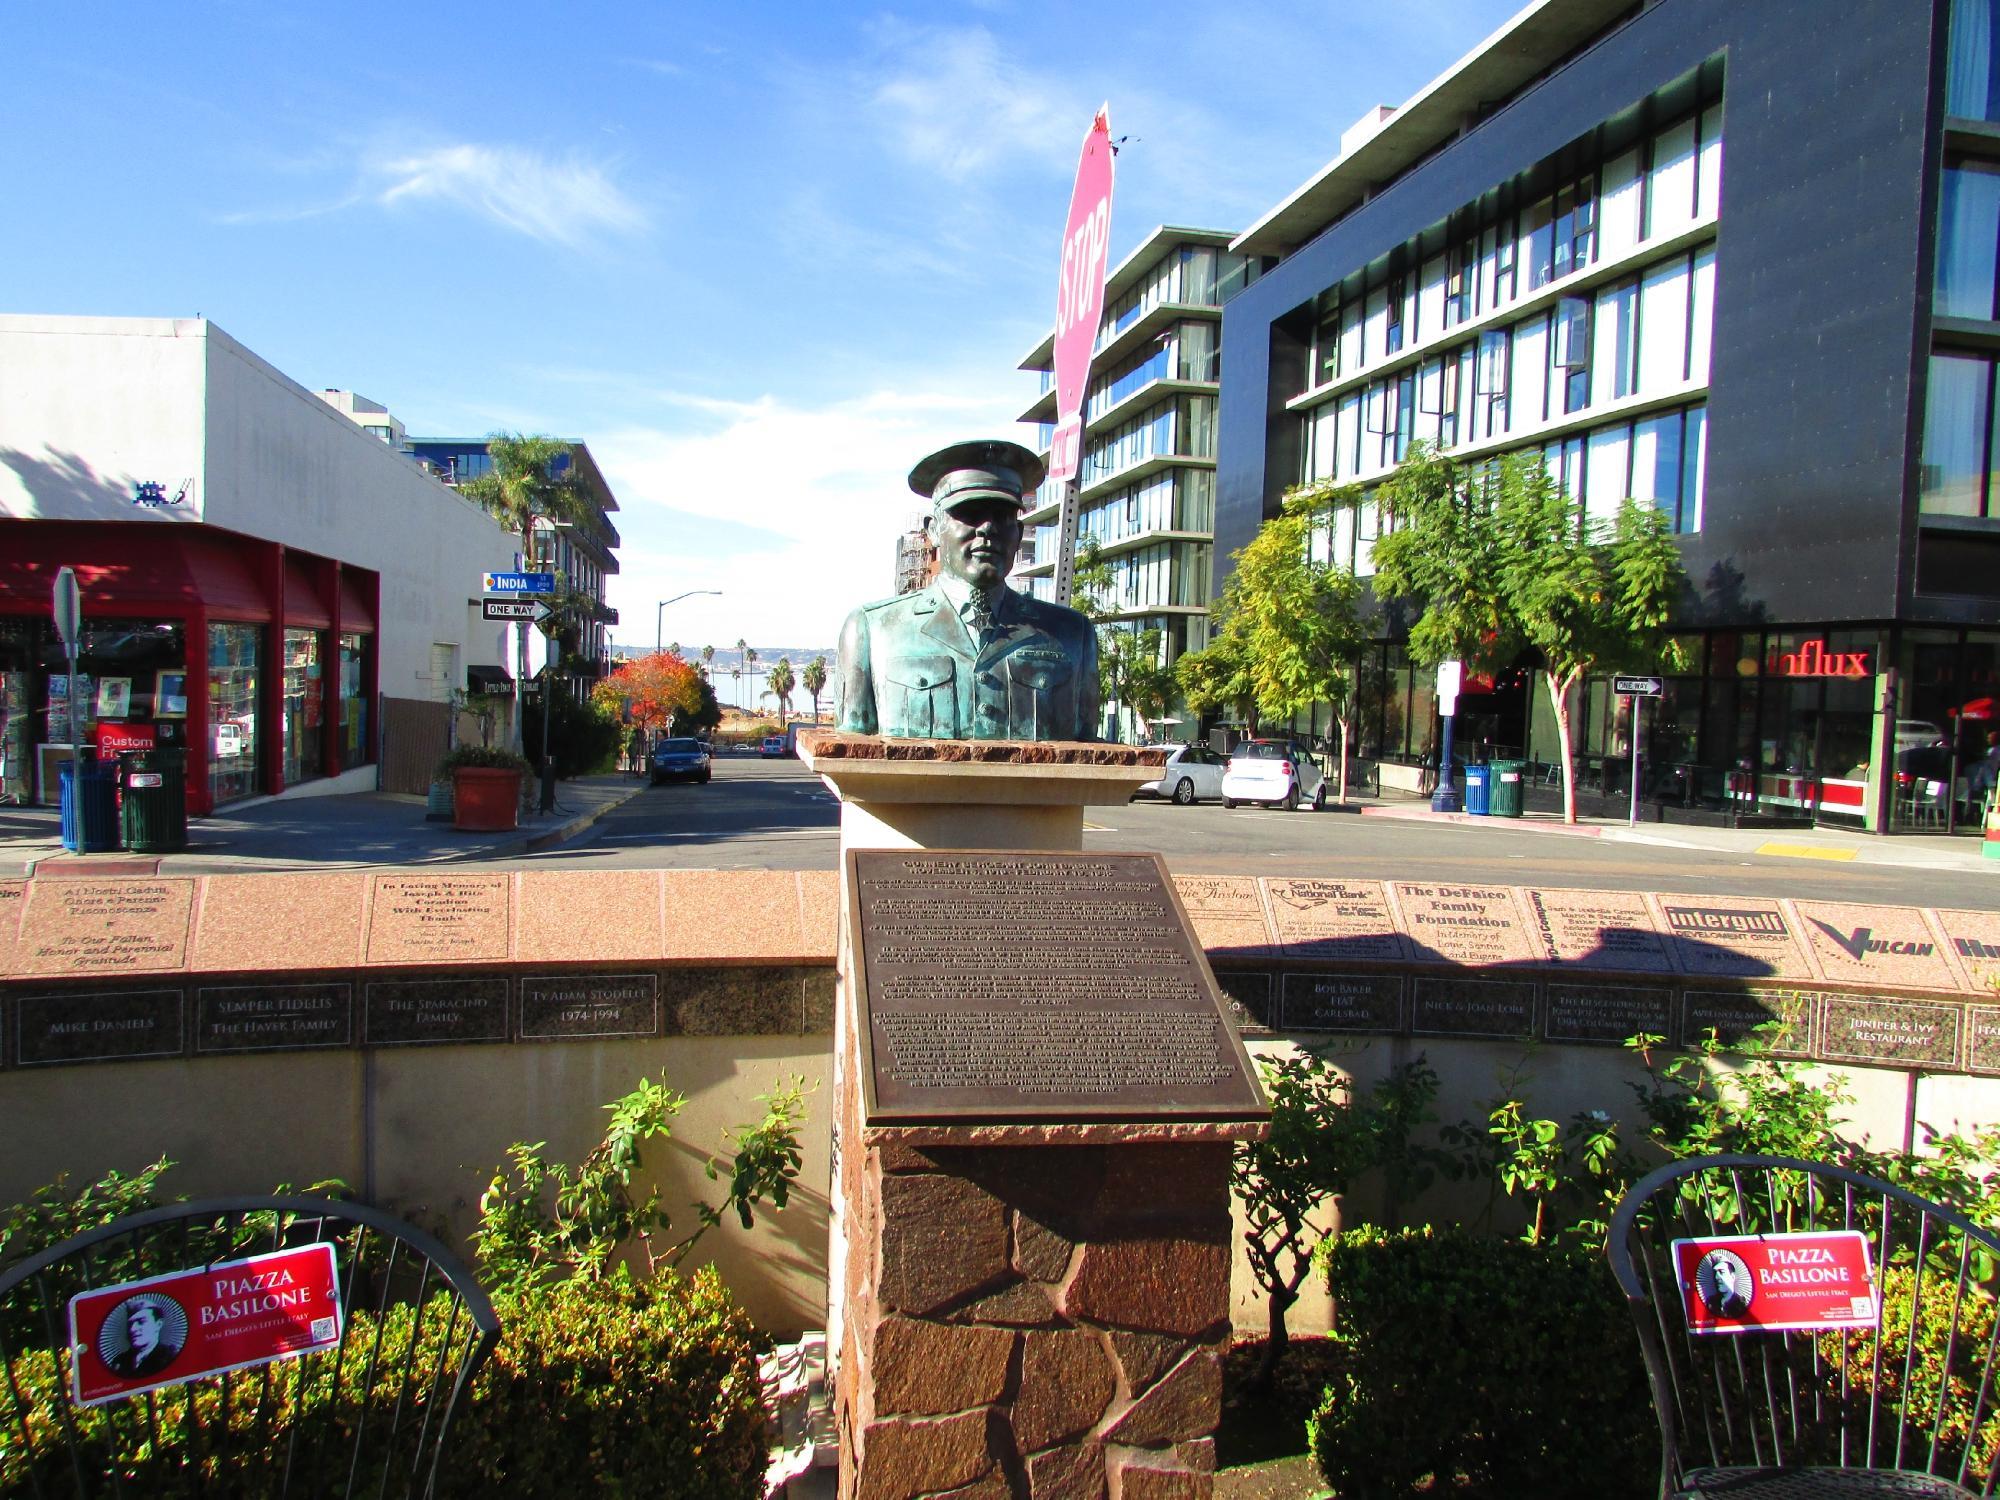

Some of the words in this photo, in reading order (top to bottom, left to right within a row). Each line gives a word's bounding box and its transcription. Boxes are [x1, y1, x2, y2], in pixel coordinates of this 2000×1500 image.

[1058, 197, 1108, 338] STOP
[497, 576, 528, 589] INDIA
[490, 606, 510, 614] ONE
[513, 606, 534, 614] WAY
[1768, 640, 1868, 677] influx
[1617, 681, 1633, 690] ONE
[1634, 682, 1648, 690] WAY
[102, 735, 153, 747] Custom
[1289, 881, 1311, 890] San
[1312, 882, 1346, 893] Diego
[1401, 886, 1434, 896] The
[1437, 887, 1507, 900] DeFalco
[1291, 889, 1337, 899] National
[1340, 891, 1368, 899] Bank
[1430, 901, 1487, 914] Family
[1414, 913, 1511, 928] Foundation
[1666, 908, 1783, 931] intergulf
[81, 936, 104, 945] Our
[109, 935, 155, 944] Fallen,
[1447, 931, 1488, 941] Memory
[1490, 932, 1501, 940] of
[1750, 934, 1790, 942] GROUP
[1806, 915, 1934, 961] VULCAN
[36, 948, 78, 957] Honor
[82, 946, 108, 954] and
[111, 943, 174, 954] Perennial
[1448, 951, 1467, 959] and
[1469, 951, 1504, 961] Eugene
[73, 956, 137, 968] Gratitude
[1314, 983, 1336, 993] BOB
[1339, 984, 1372, 994] BAKER
[551, 991, 586, 1001] ADAM
[218, 1000, 273, 1013] SEMPER
[278, 998, 332, 1011] FIDELIS
[388, 1000, 414, 1011] THE
[1425, 1000, 1452, 1010] NICK
[1455, 1002, 1464, 1011] &
[1466, 1002, 1495, 1013] JOAN
[415, 1012, 462, 1023] FAMILY
[1314, 1008, 1369, 1018] CARLSBAD
[50, 1021, 89, 1035] MIKE
[93, 1018, 155, 1032] DANIELS
[211, 1023, 241, 1035] THE
[292, 1018, 339, 1031] FAMILY
[1850, 1018, 1897, 1031] JUNIPER
[1900, 1021, 1912, 1032] &
[1914, 1022, 1934, 1033] IVY
[1855, 1031, 1930, 1046] RESTAURANT
[1767, 1247, 1835, 1265] PIAZZA
[1758, 1267, 1850, 1285] BASILONE
[215, 1267, 295, 1300] PIAZZA
[1765, 1291, 1779, 1299] SAN
[1779, 1290, 1807, 1299] DIEGO'S
[1807, 1290, 1830, 1298] LITTLE
[1830, 1289, 1849, 1297] ITALY
[200, 1286, 312, 1326] BASILONE
[206, 1332, 222, 1341] SAN
[224, 1325, 258, 1338] DIEGO'S
[260, 1317, 286, 1329] LITTLE
[287, 1312, 310, 1324] ITALY
